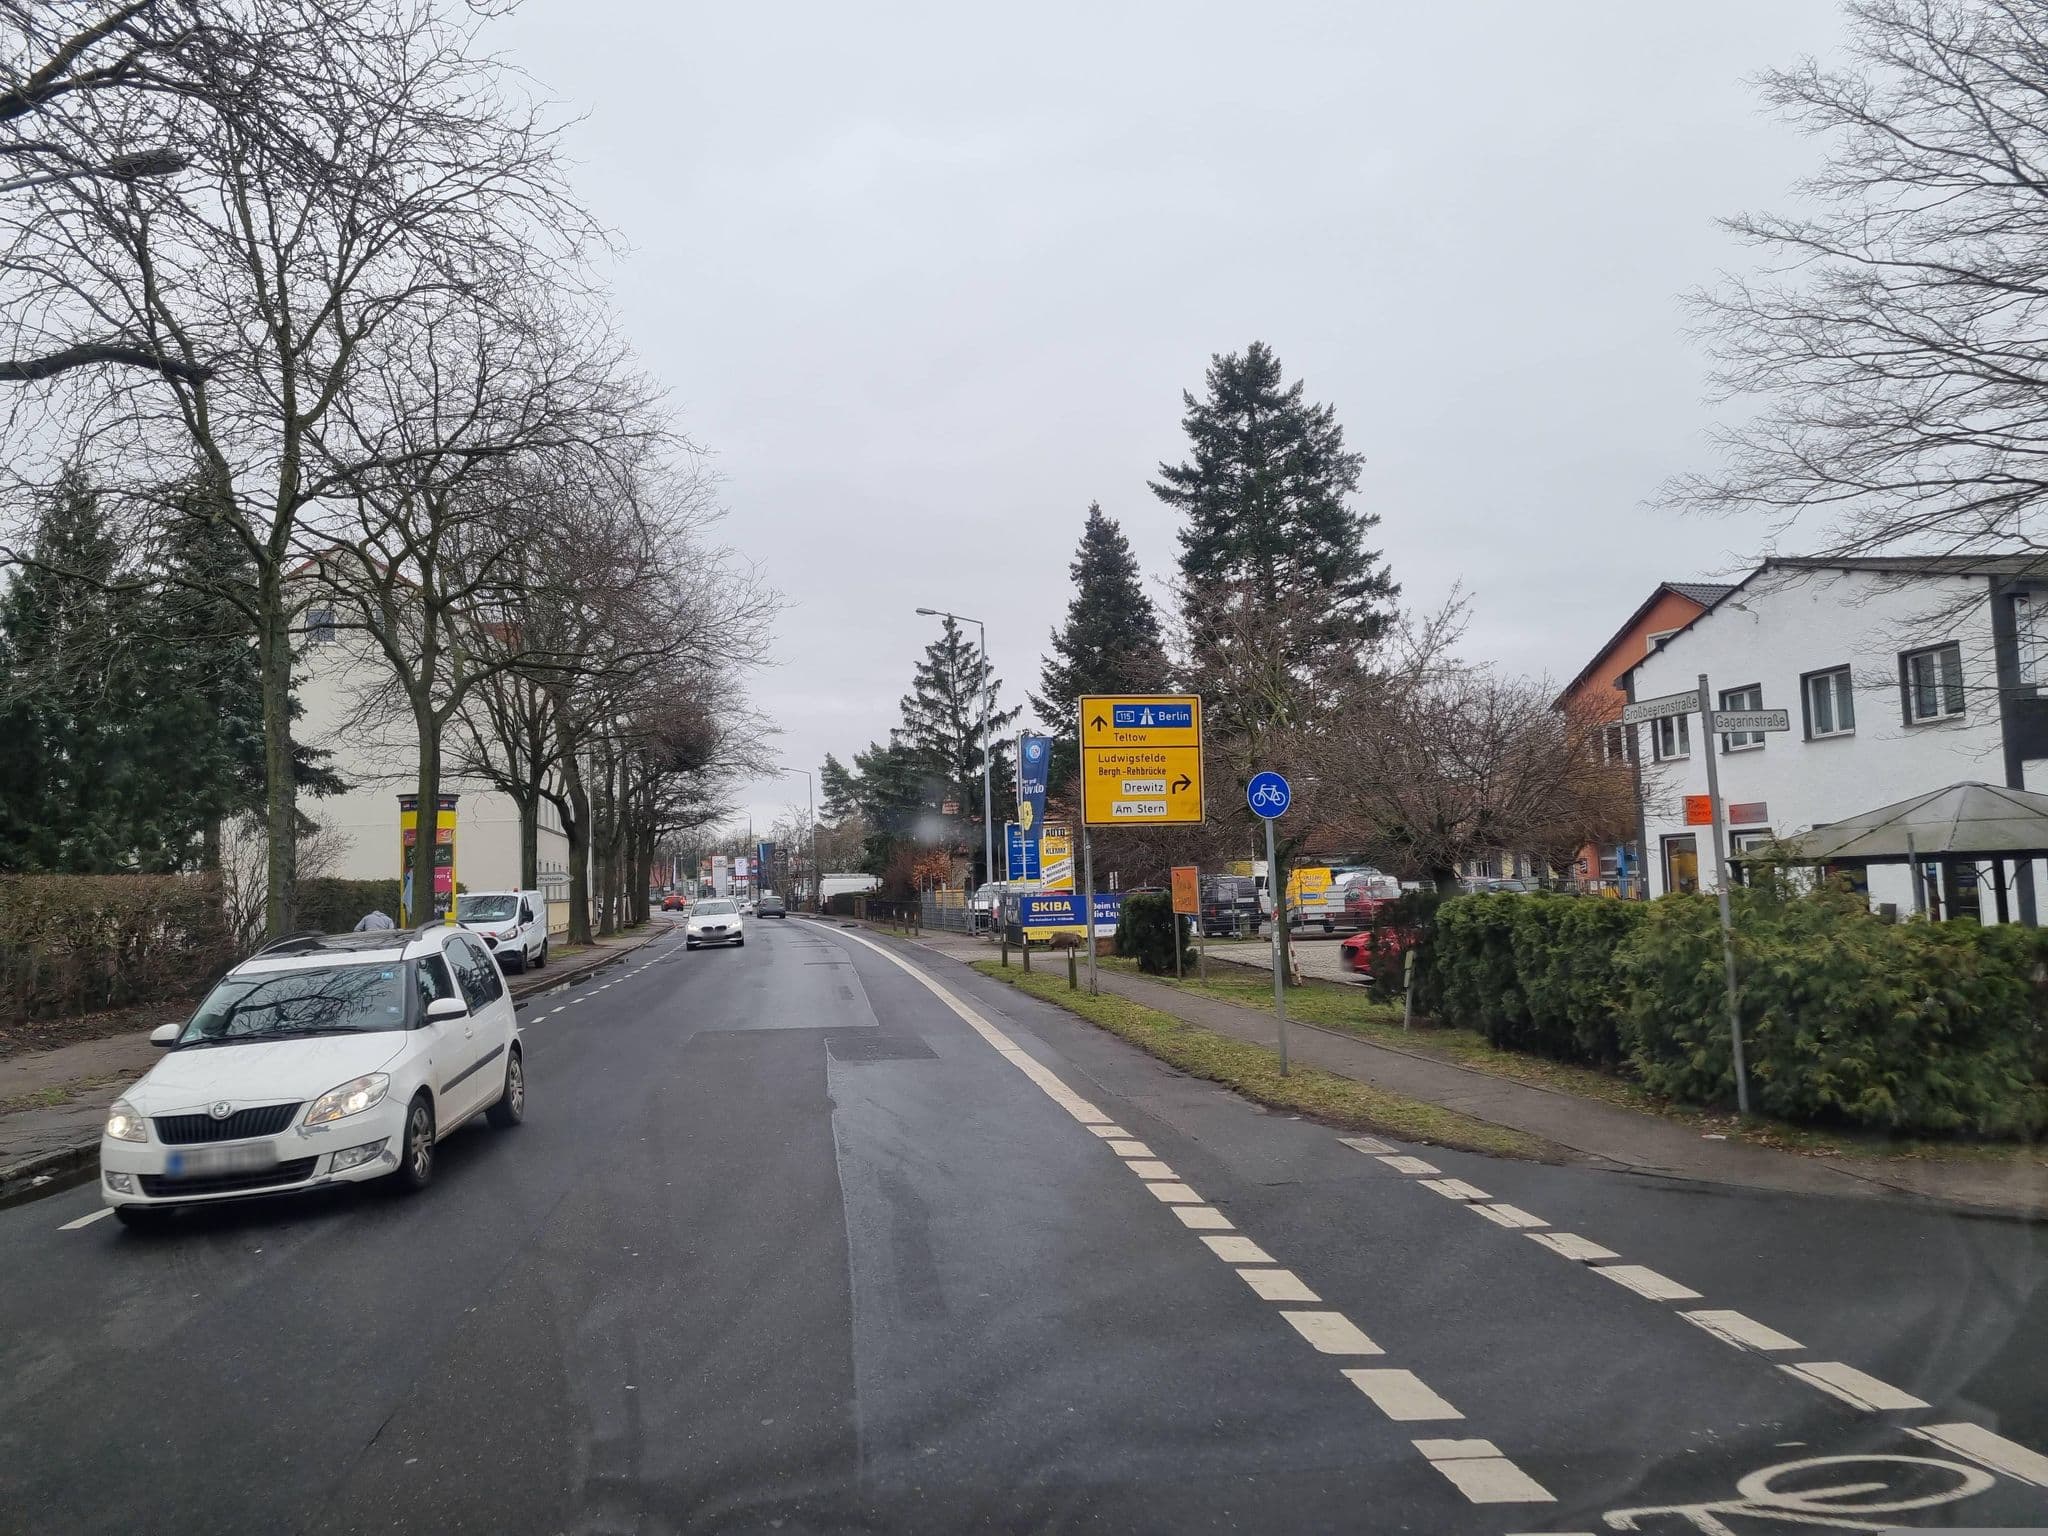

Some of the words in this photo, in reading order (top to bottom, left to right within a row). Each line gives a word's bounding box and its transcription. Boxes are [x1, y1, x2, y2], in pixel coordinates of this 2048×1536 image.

[1623, 695, 1698, 721] Großbeerenstraße
[1119, 712, 1131, 720] 115
[1158, 711, 1189, 721] Berlin
[1715, 714, 1786, 731] Gagarinstraße
[1114, 732, 1147, 742] Teltow
[1098, 753, 1166, 764] Ludwigsfelde
[1124, 783, 1164, 792] Drewitz
[1115, 805, 1132, 814] Am
[1137, 804, 1165, 813] Stern
[1045, 828, 1066, 837] AUTO
[1031, 901, 1072, 912] SKIBA
